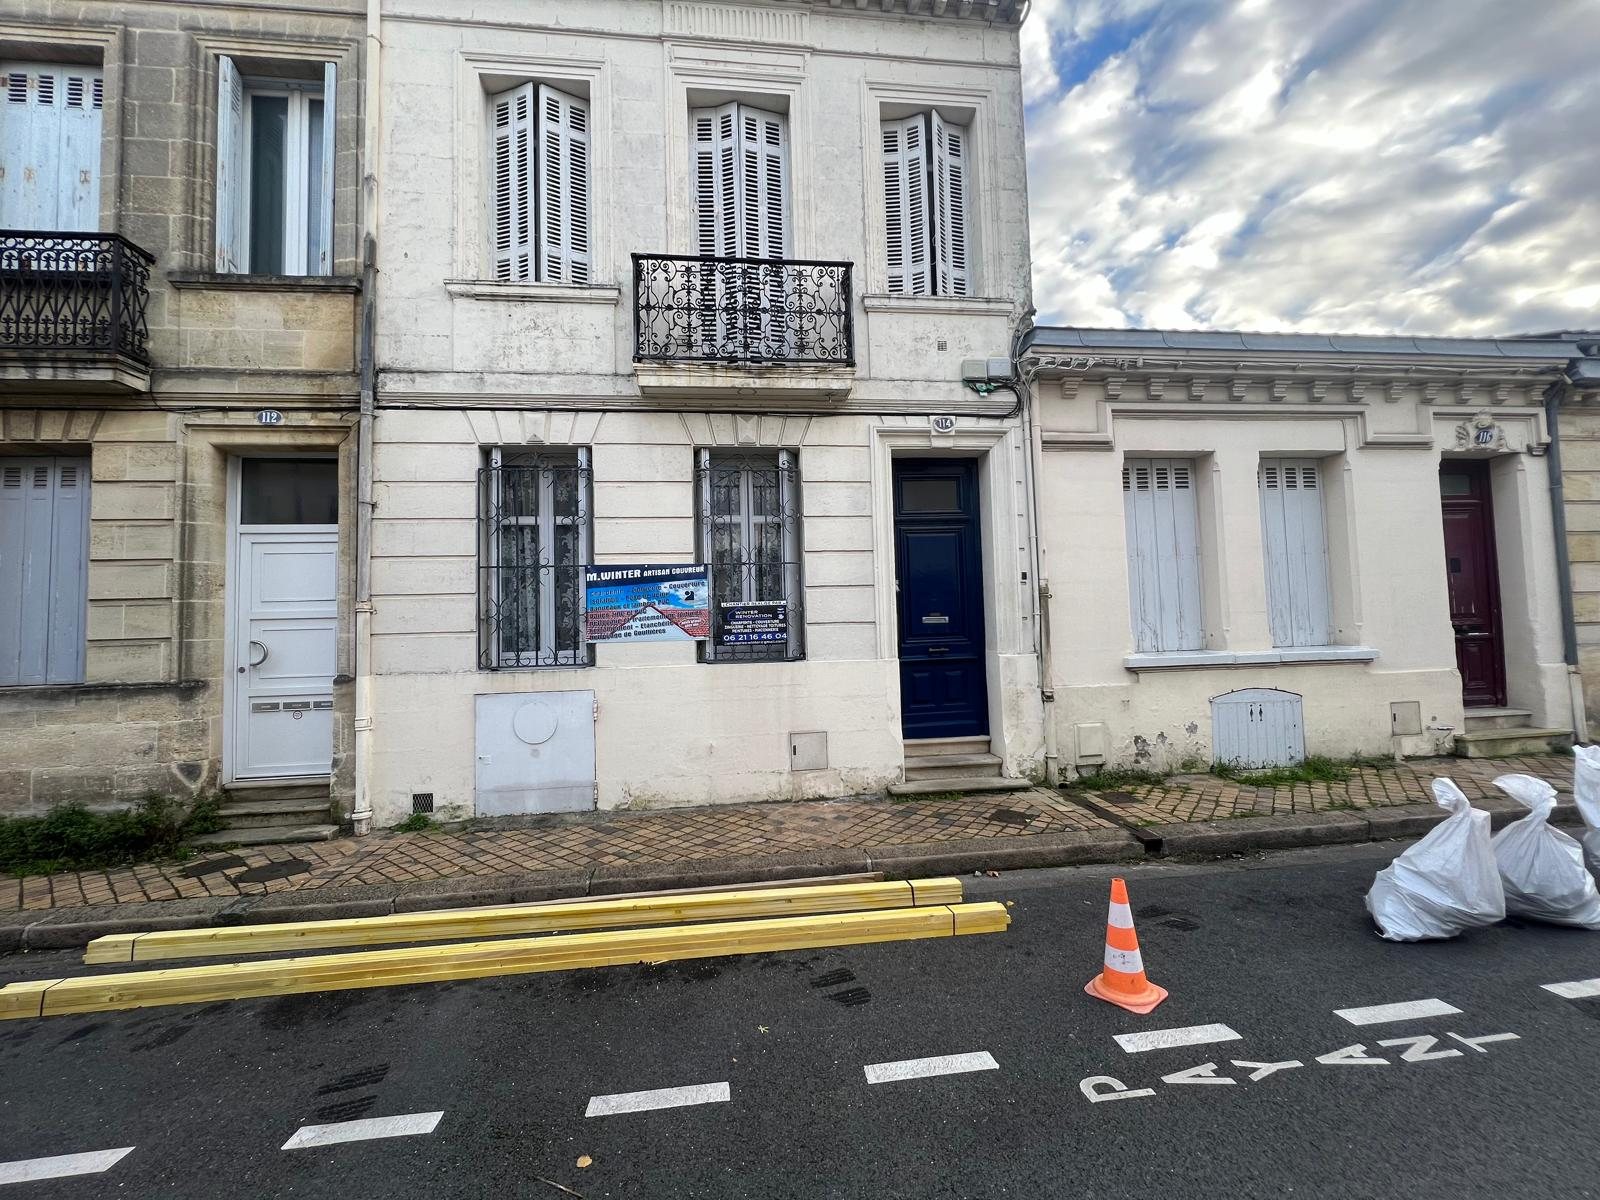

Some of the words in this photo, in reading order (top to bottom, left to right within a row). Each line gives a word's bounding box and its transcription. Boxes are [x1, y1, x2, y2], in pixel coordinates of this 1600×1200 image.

[261, 411, 277, 423] 112
[938, 419, 951, 428] 114
[586, 569, 641, 582] M.WINTER
[643, 568, 670, 577] ARTISAN
[671, 566, 705, 575] COUVREUR
[1079, 1032, 1521, 1103] PAYANT
